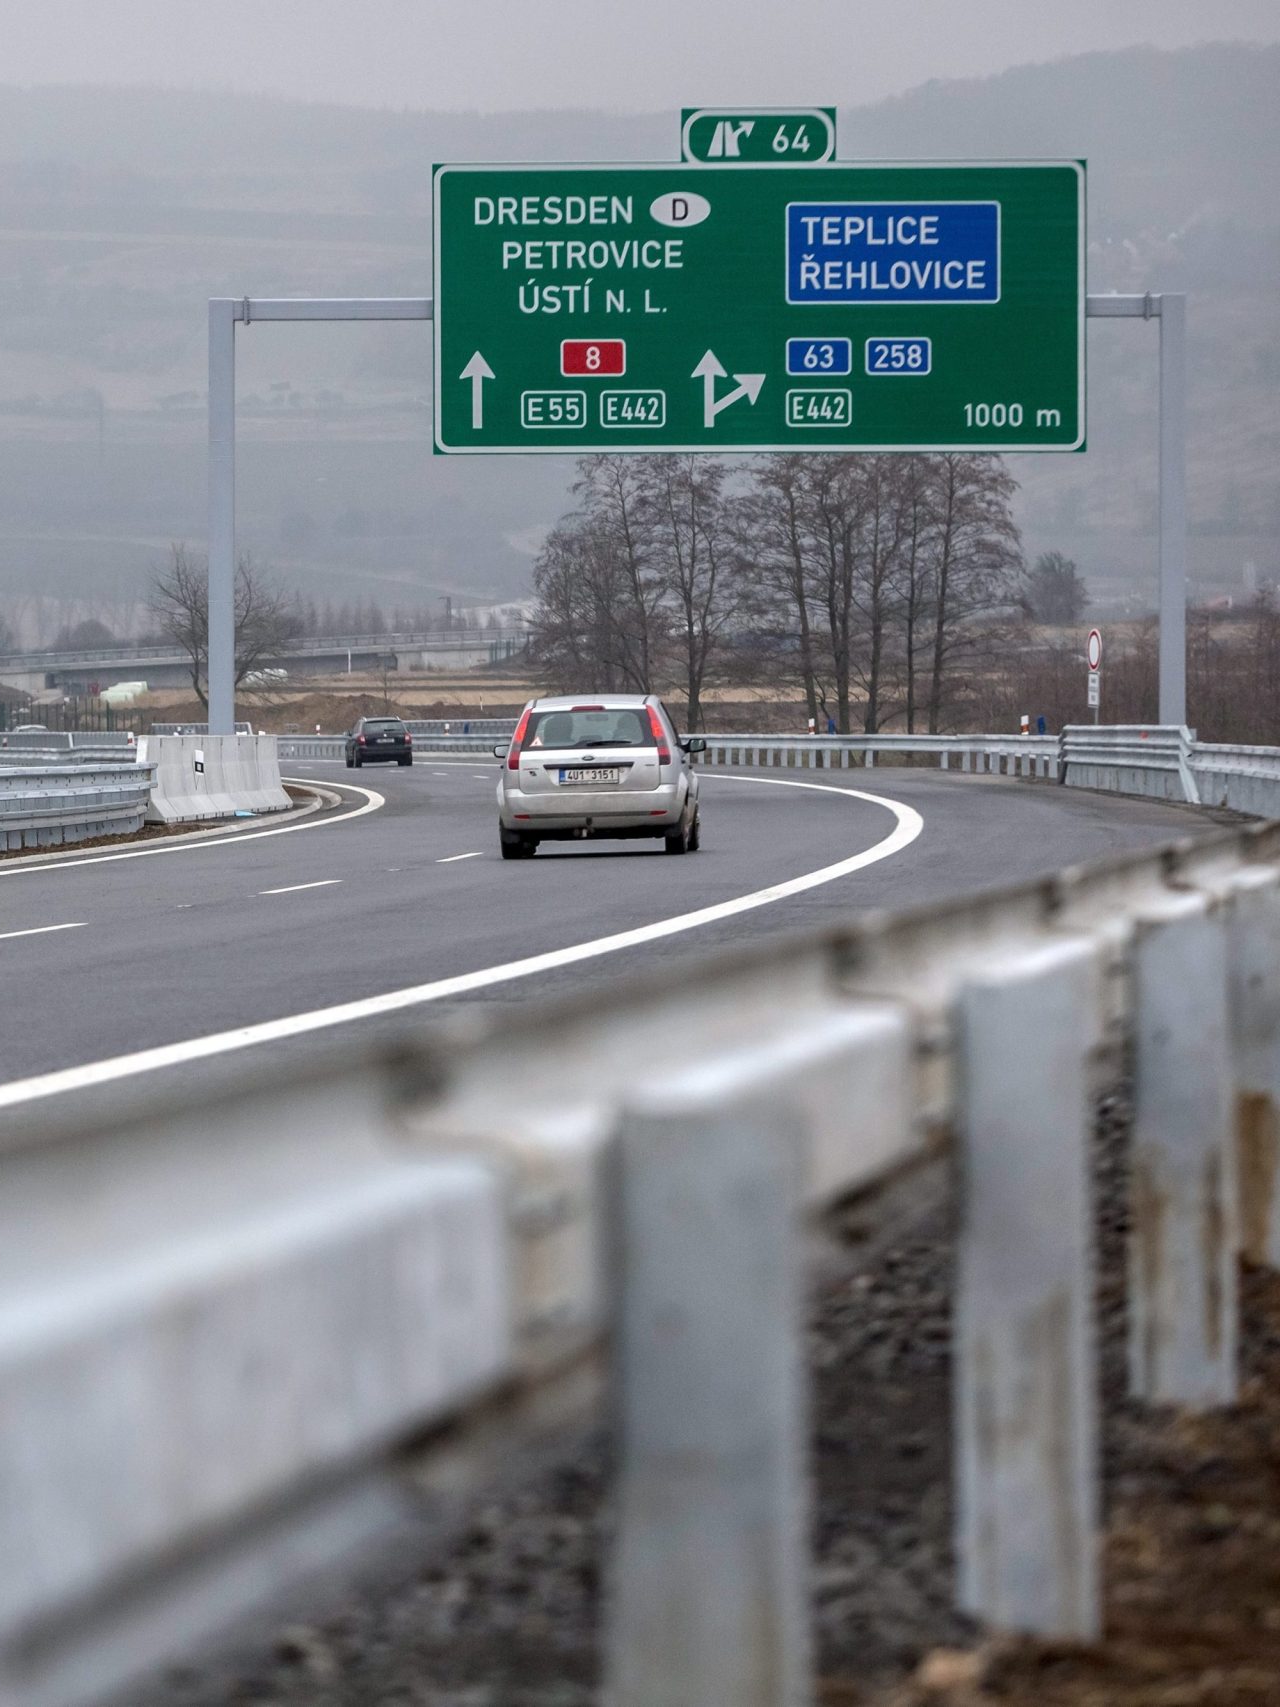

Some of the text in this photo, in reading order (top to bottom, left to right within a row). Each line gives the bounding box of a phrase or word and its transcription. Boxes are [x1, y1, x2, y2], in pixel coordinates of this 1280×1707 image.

[772, 124, 810, 153] 64
[474, 196, 689, 225] DRESDEN D
[801, 216, 939, 245] TEPLICE
[502, 240, 683, 269] PETROVICE
[800, 253, 986, 290] ŘEHLOVICE
[518, 278, 668, 314] ÚSTÍ N. L.
[585, 346, 601, 370] 8
[803, 344, 922, 369] 63 258
[964, 403, 1061, 427] 1000 m
[591, 769, 614, 780] 3151
